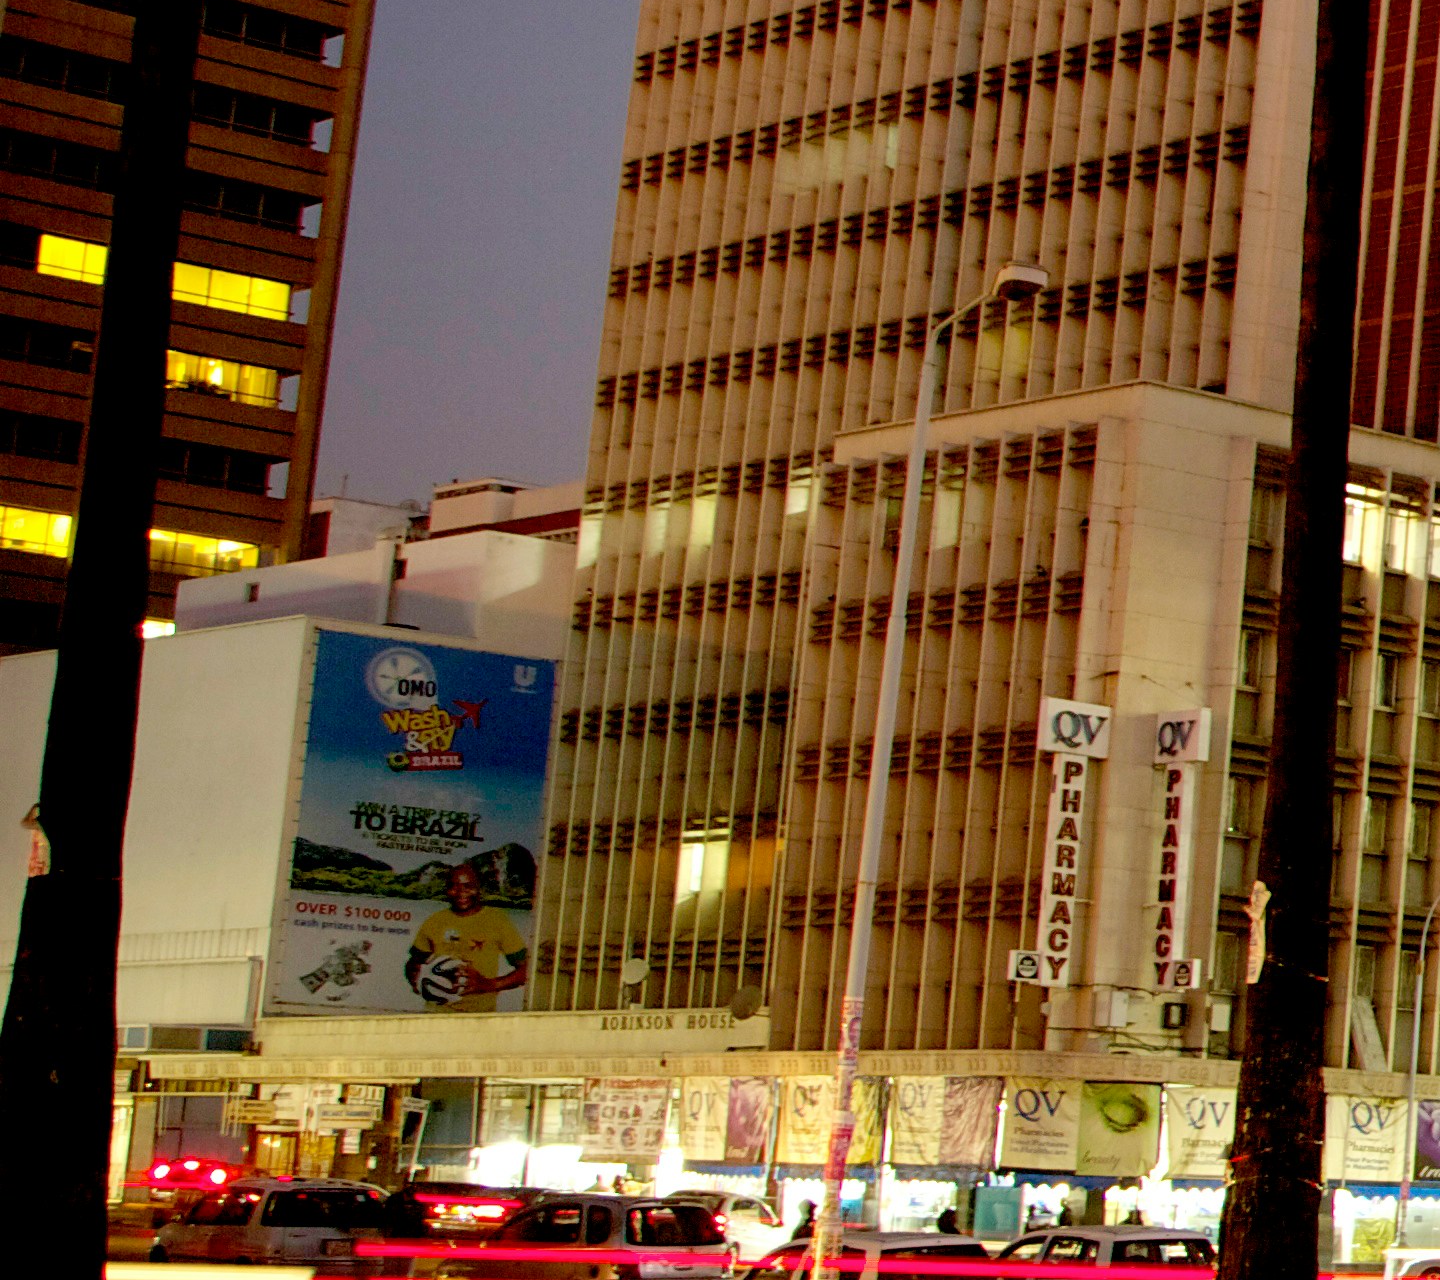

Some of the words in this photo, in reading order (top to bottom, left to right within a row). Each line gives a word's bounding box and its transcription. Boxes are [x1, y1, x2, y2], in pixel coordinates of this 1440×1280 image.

[398, 679, 436, 698] OMO
[382, 704, 451, 734] Wash
[1053, 710, 1108, 748] QV
[1158, 720, 1197, 756] QV
[411, 755, 463, 766] BRAZIL
[350, 810, 385, 831] TO
[391, 814, 484, 842] BRAZIL
[402, 806, 436, 818] TRIP
[1045, 761, 1083, 981] PHARMACY
[1154, 769, 1182, 986] PHARMACY
[296, 901, 337, 915] OVER
[344, 905, 381, 919] $100
[384, 910, 412, 921] 000
[600, 1014, 674, 1030] ROBINSON
[686, 1013, 736, 1029] HOUSE
[1014, 1088, 1066, 1122] QV
[1185, 1097, 1231, 1129] QV
[1350, 1101, 1393, 1135] QV
[1182, 1137, 1228, 1148] Pharmaci
[1347, 1140, 1395, 1154] Pharmacies
